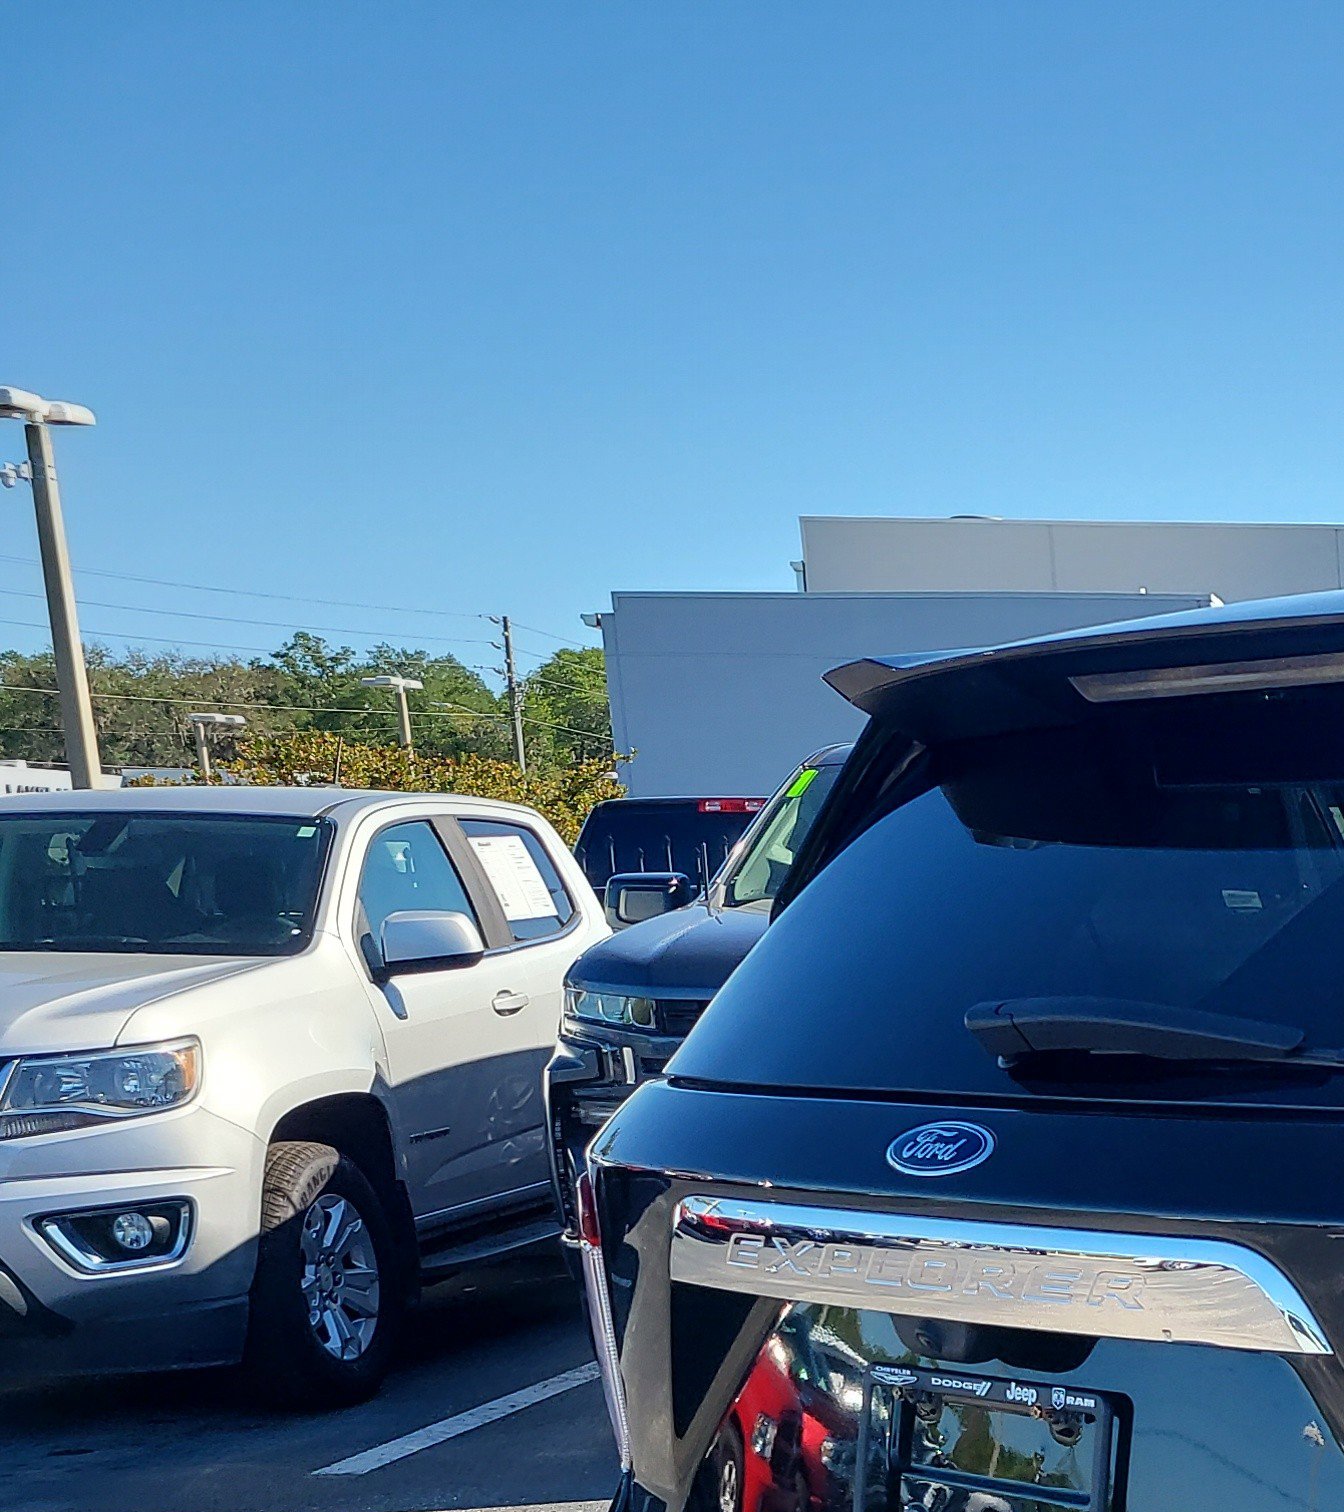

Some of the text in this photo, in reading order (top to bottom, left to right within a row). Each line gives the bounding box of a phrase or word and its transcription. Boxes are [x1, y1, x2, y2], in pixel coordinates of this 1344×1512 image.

[901, 1128, 968, 1161] Ford
[725, 1231, 1149, 1312] EXPLORER
[930, 1376, 984, 1393] DODGE
[1006, 1381, 1038, 1406] Jeep
[1066, 1395, 1096, 1409] RAM
